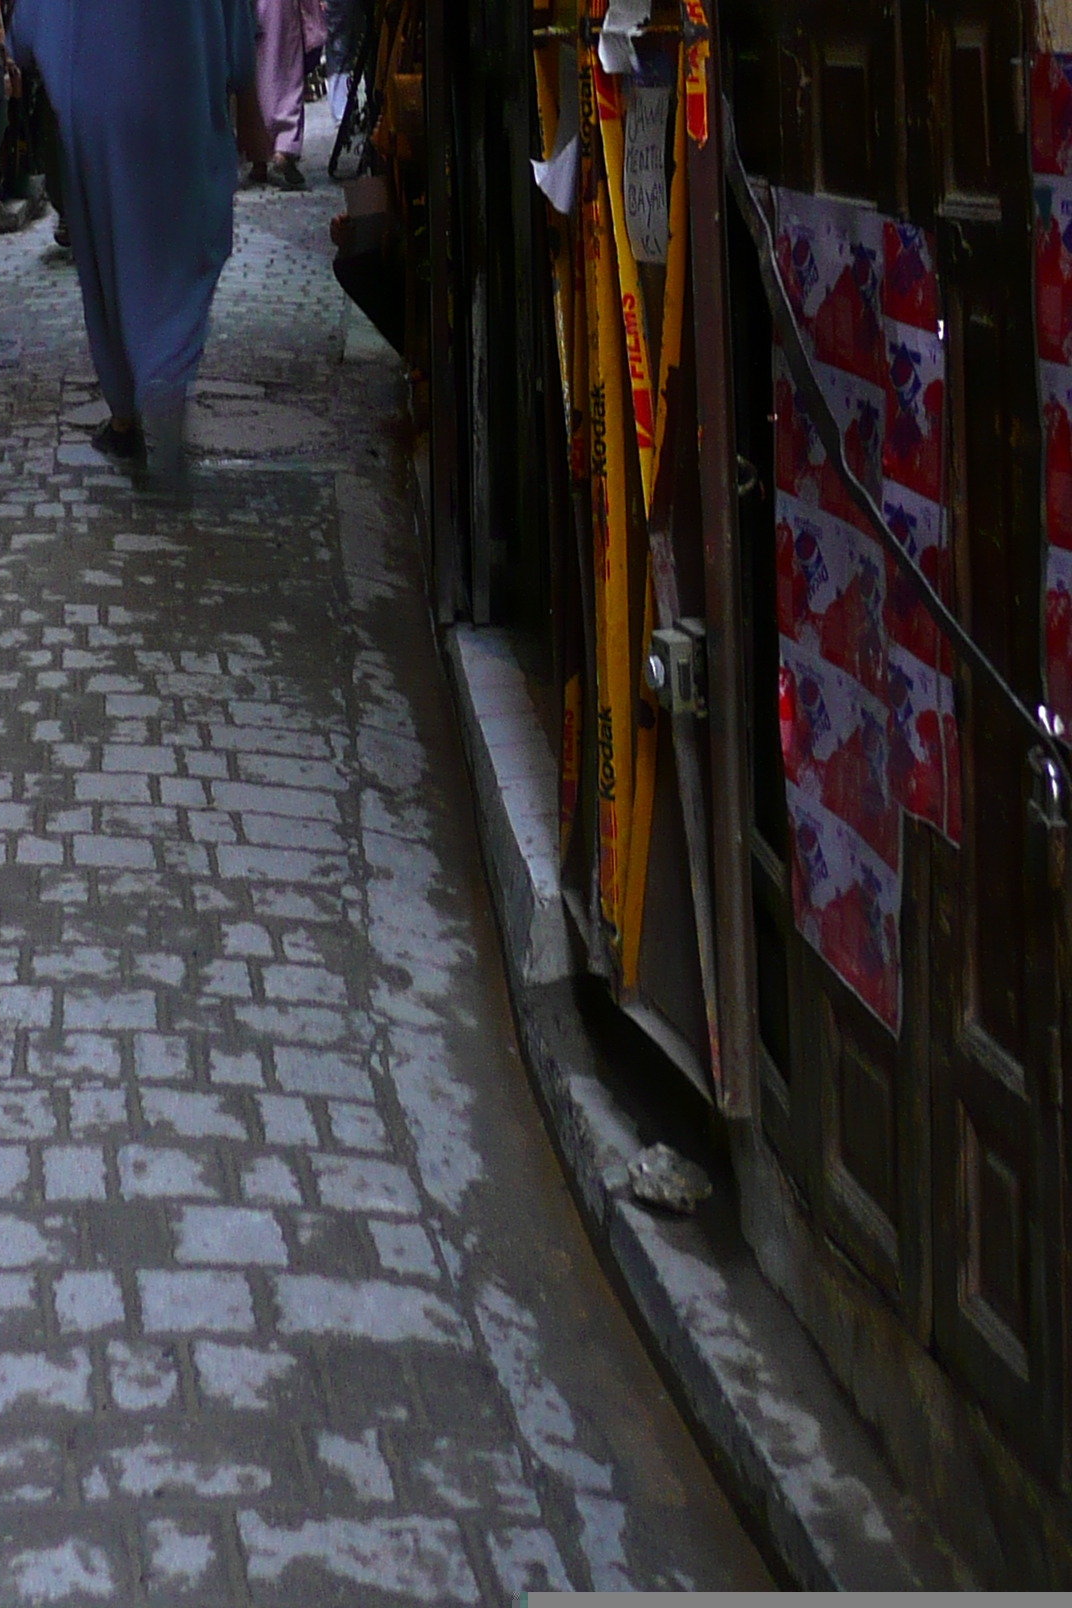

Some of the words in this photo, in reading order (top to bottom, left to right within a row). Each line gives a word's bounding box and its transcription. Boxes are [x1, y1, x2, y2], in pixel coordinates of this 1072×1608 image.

[579, 65, 594, 158] Kodak
[622, 293, 644, 380] FILMS
[591, 382, 607, 477] Kodak
[597, 704, 615, 801] Kodak
